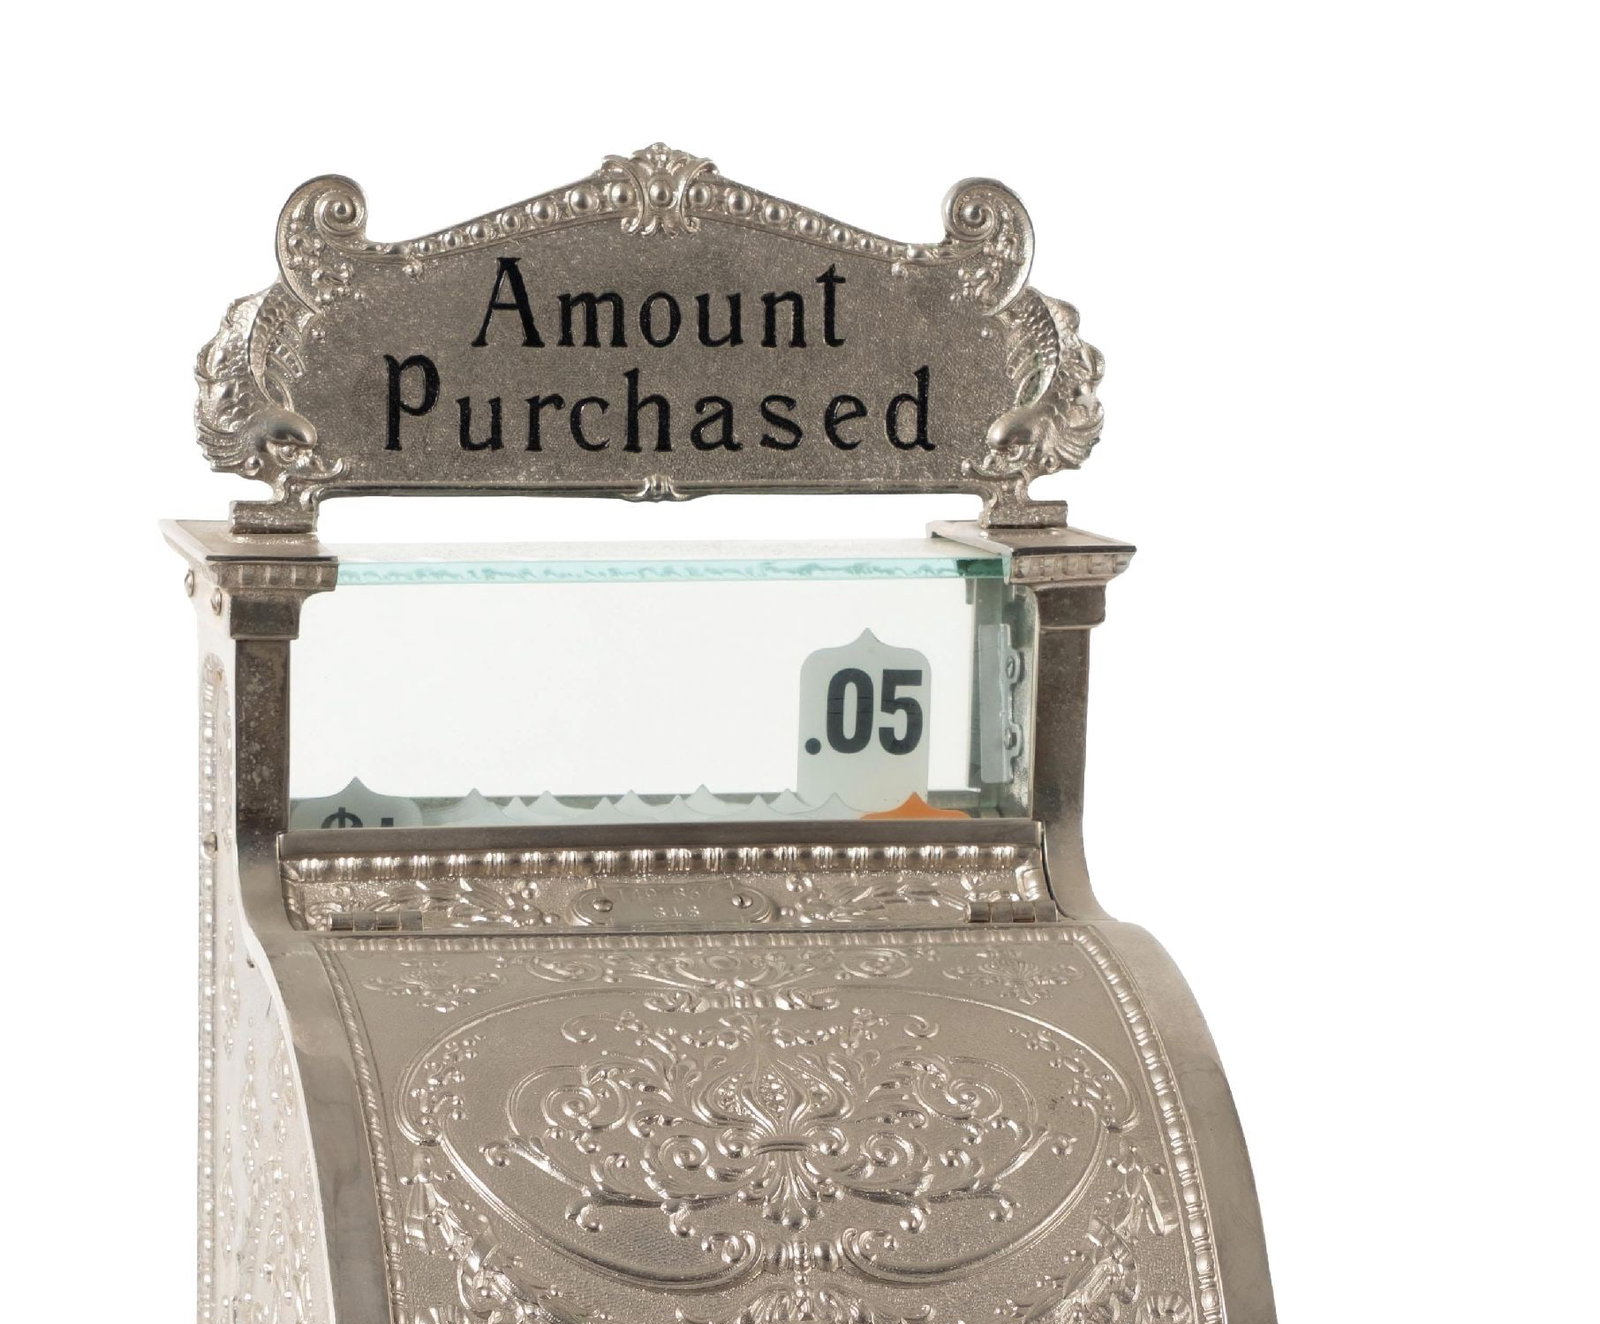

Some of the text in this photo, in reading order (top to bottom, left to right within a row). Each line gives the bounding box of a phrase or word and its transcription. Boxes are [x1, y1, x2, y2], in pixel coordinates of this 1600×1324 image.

[470, 257, 849, 349] Amount
[383, 355, 937, 454] Purchased
[803, 668, 923, 756] .05
